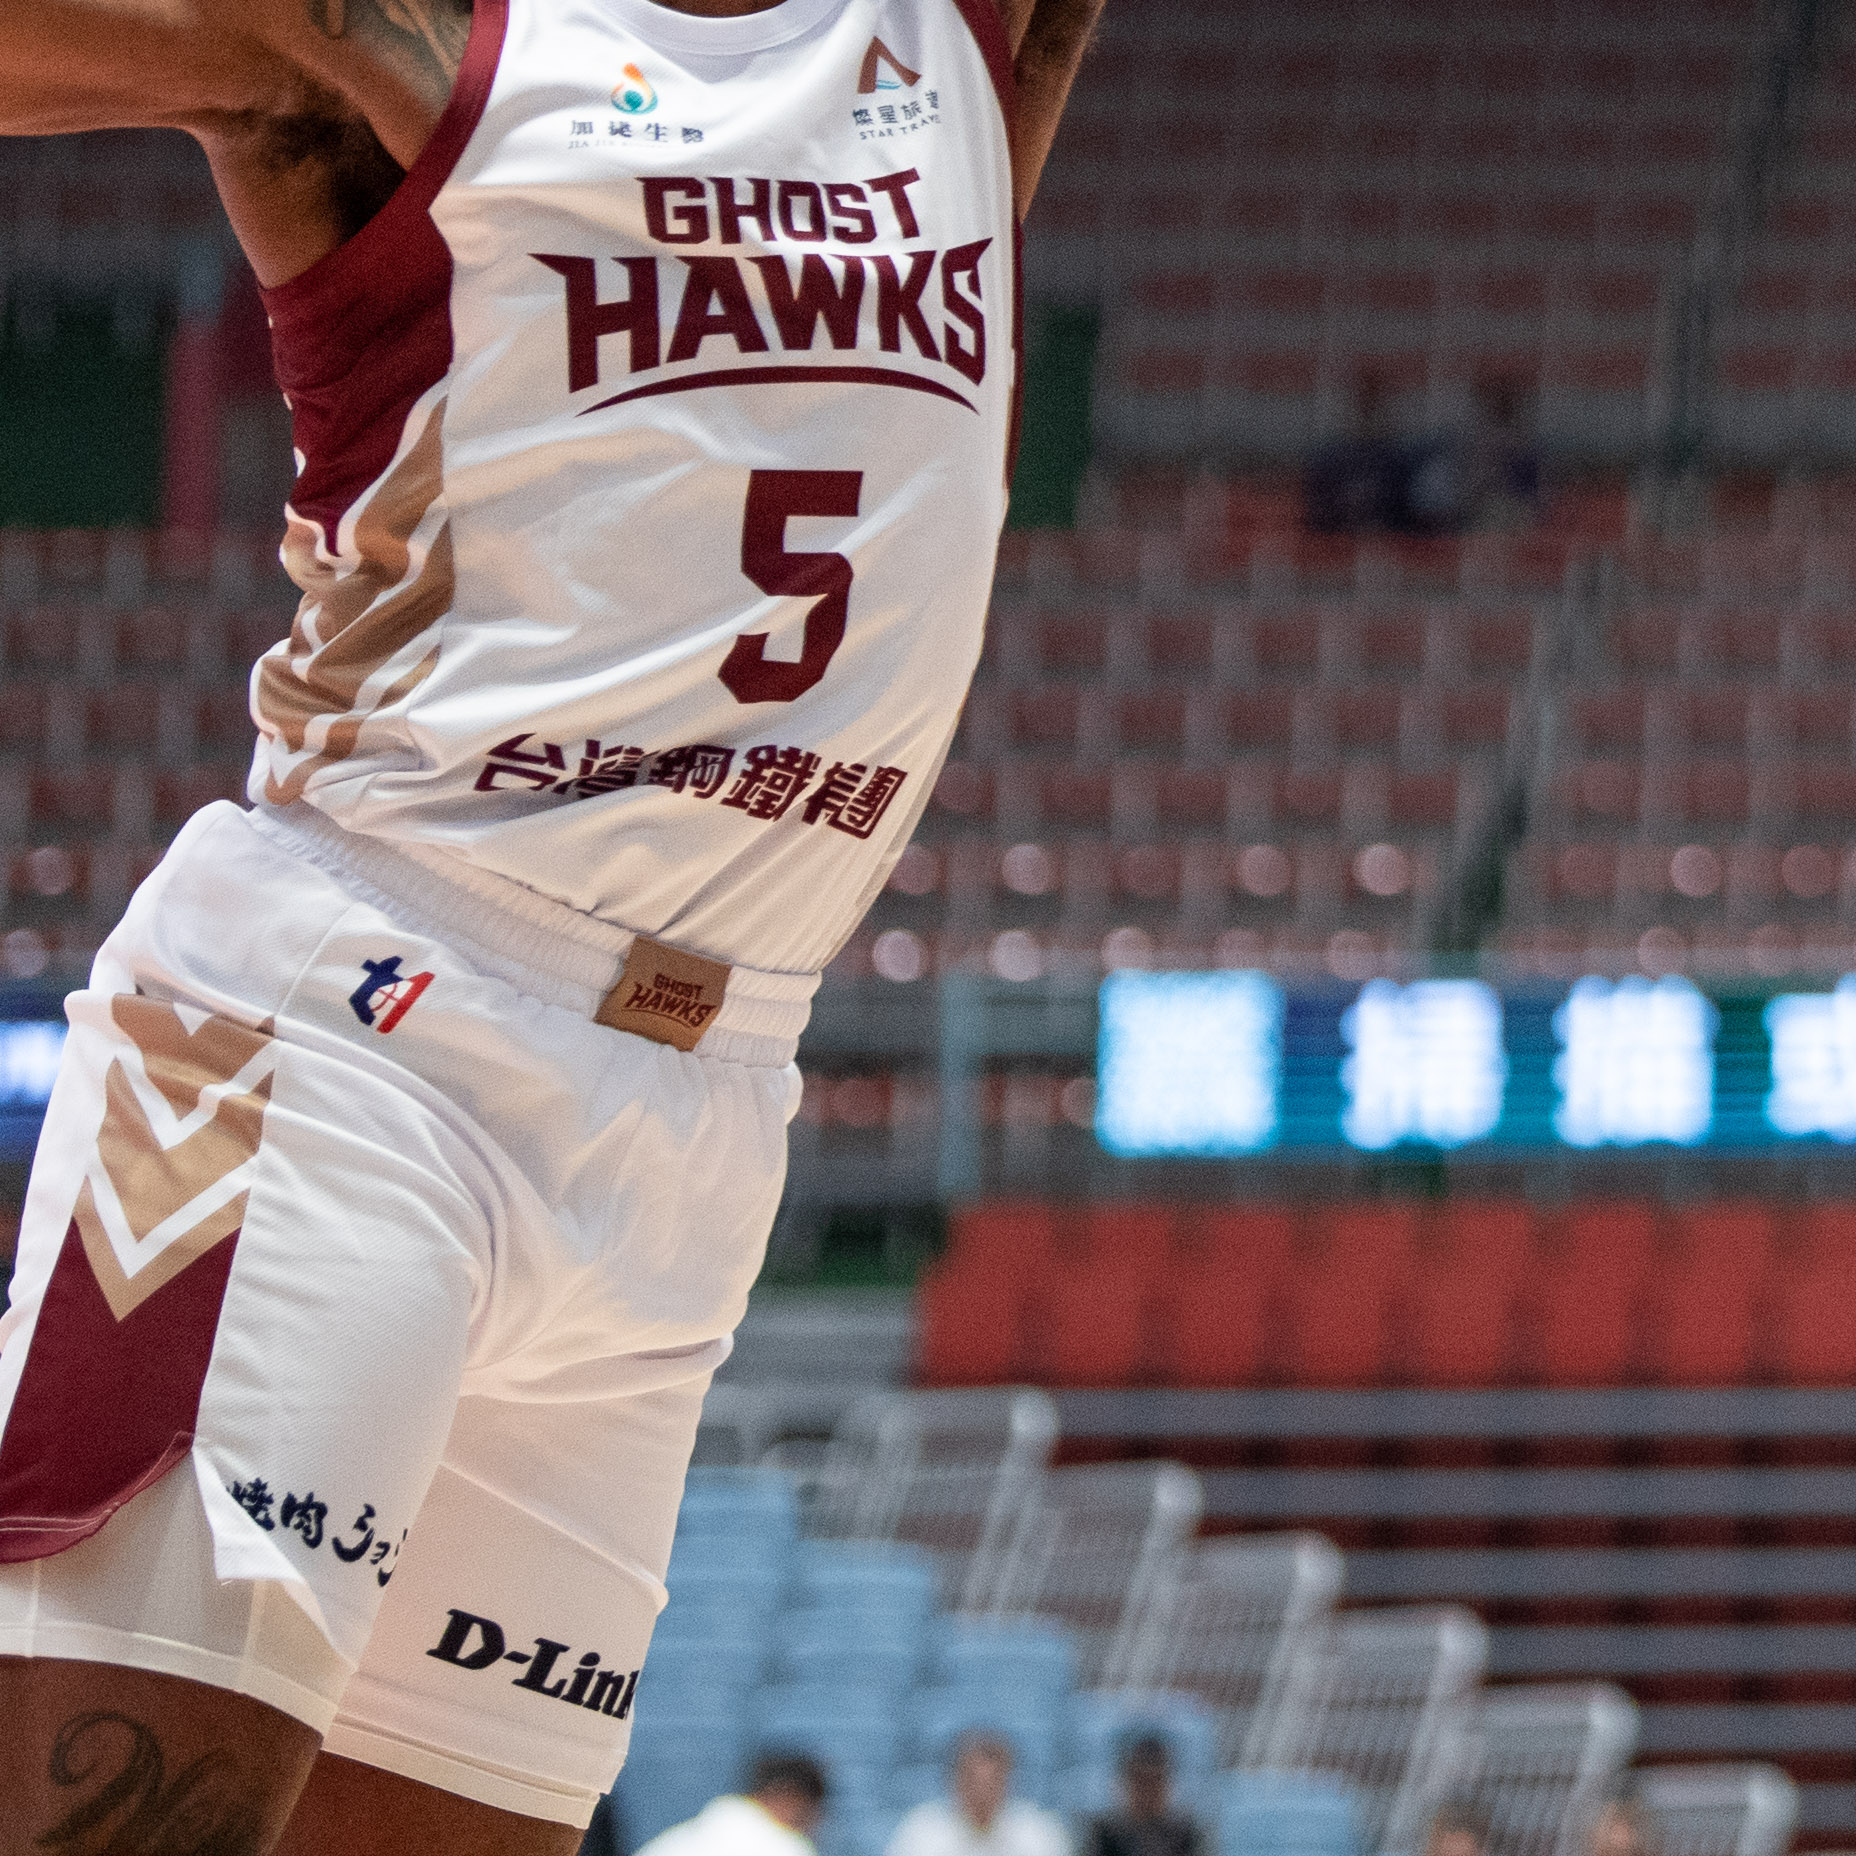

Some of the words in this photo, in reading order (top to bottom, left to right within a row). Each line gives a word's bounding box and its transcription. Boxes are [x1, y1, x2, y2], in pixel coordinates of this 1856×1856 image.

[635, 167, 921, 244] GHOST
[528, 237, 993, 393] HAWKS
[718, 469, 863, 704] 5
[624, 981, 717, 1028] HAWKS
[653, 972, 704, 1000] GHOST
